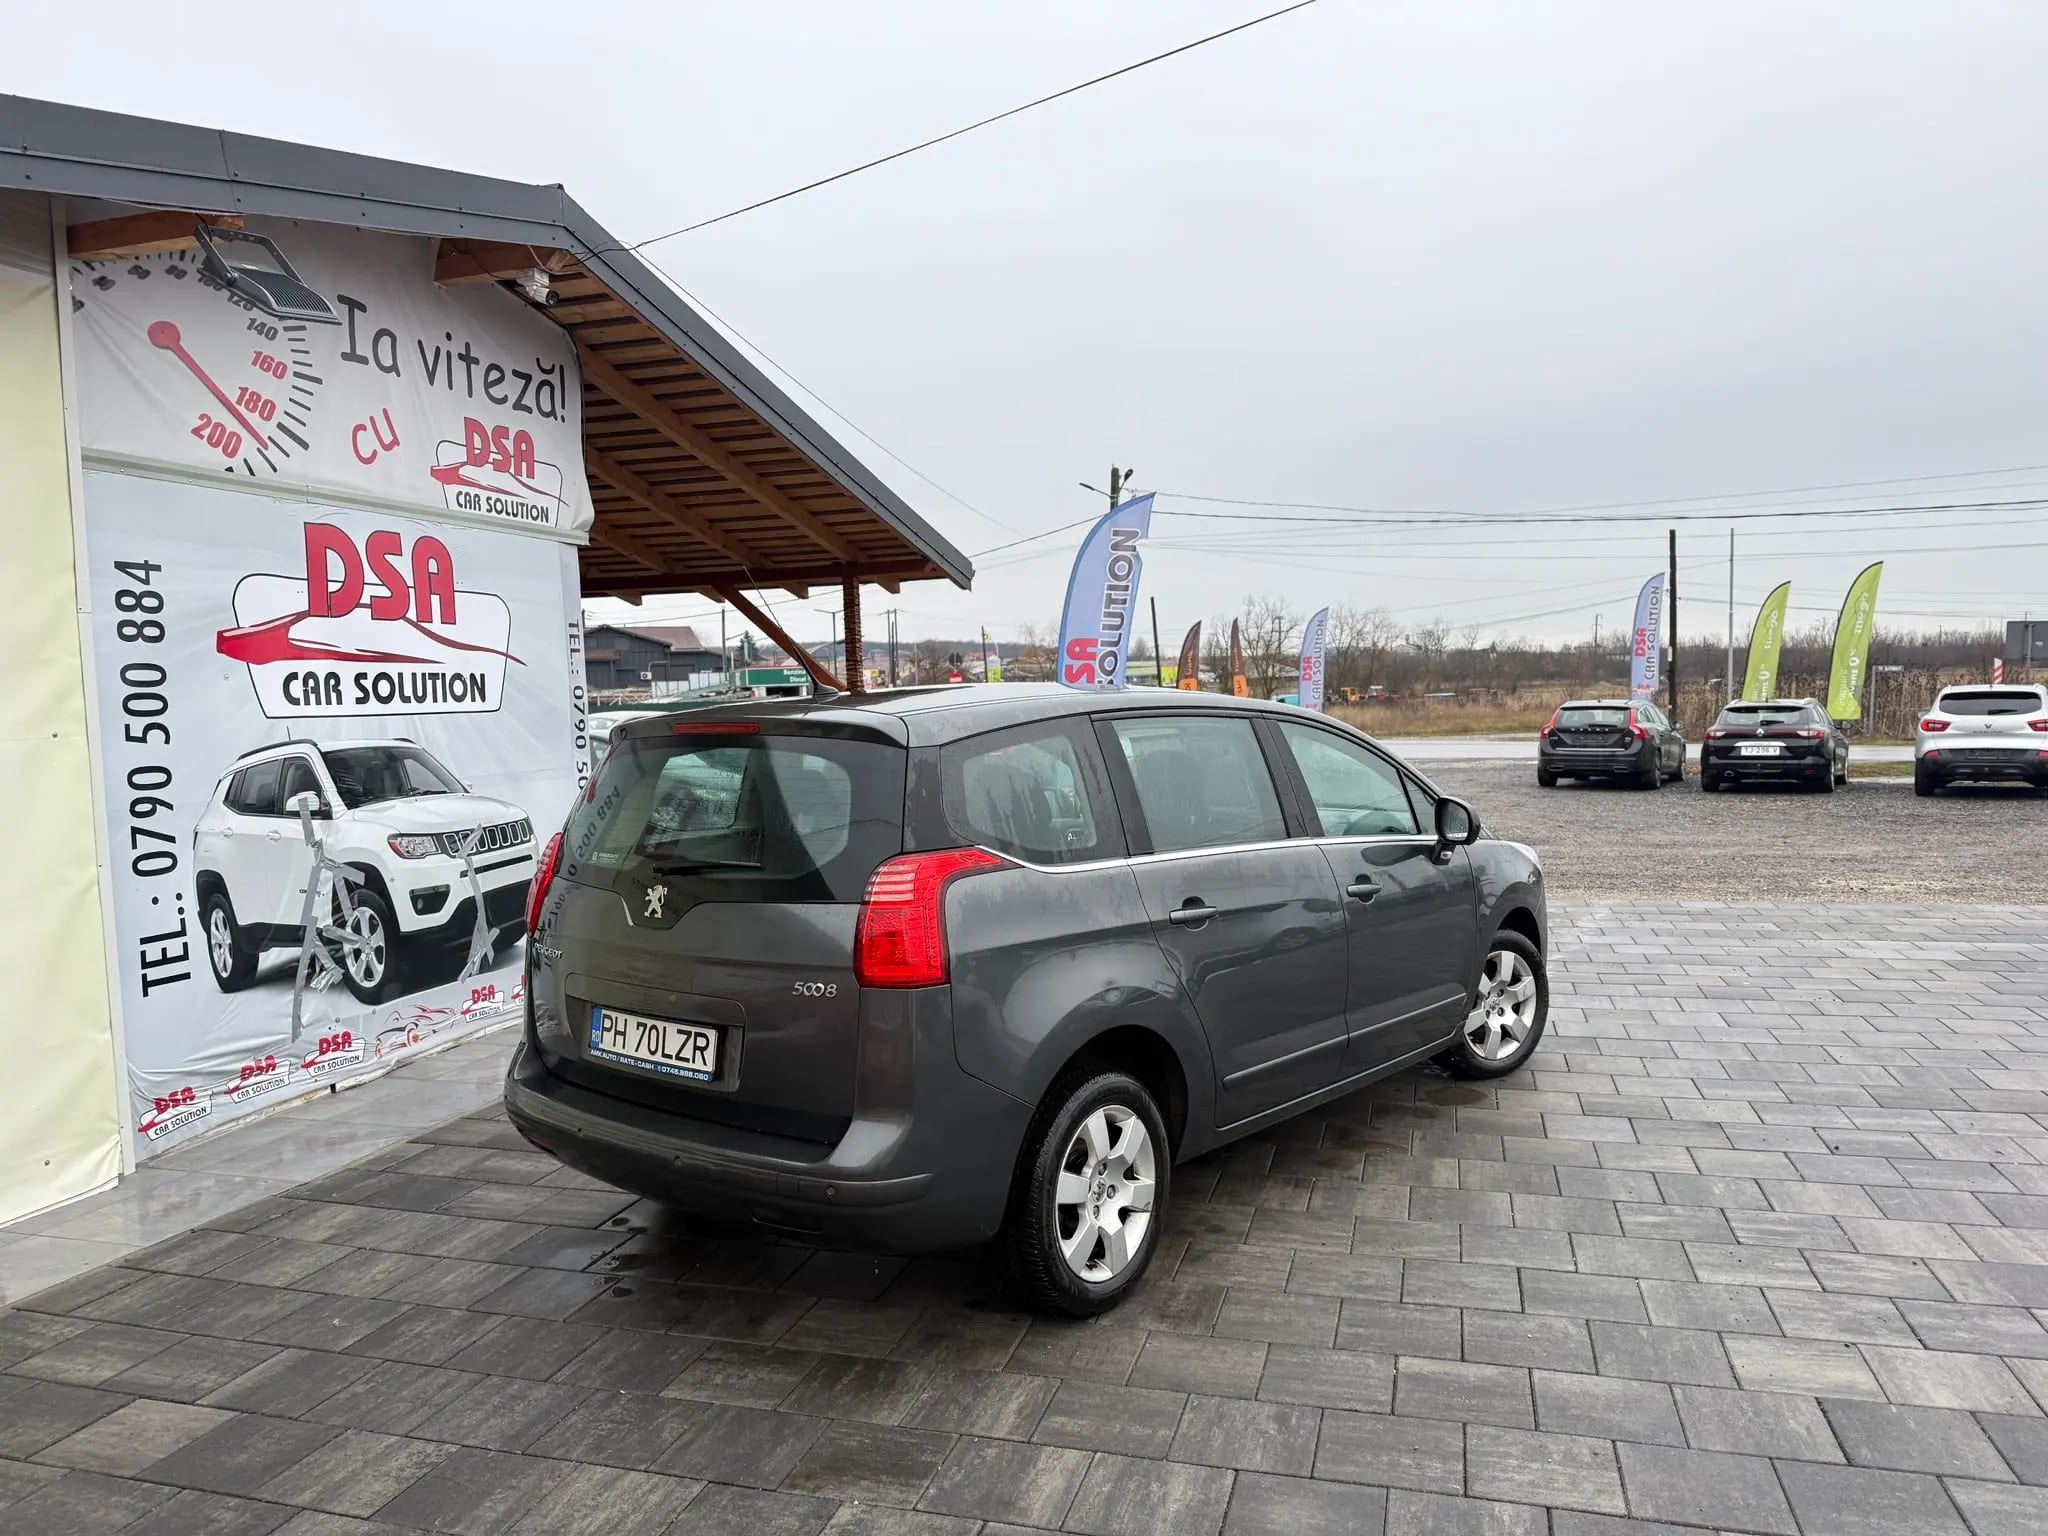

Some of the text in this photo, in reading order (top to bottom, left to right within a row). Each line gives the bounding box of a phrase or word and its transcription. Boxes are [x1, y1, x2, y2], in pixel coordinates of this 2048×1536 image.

[246, 317, 279, 342] 140
[251, 350, 288, 380] 160
[336, 293, 566, 424] Ia viteză!
[235, 386, 277, 423] 180
[190, 412, 243, 459] 200
[351, 407, 400, 466] cu
[463, 416, 535, 480] DSA
[456, 490, 549, 524] CAR SOLUTION
[303, 521, 457, 625] DSA
[568, 618, 581, 675] TEL.:
[1634, 627, 1647, 657] DSA
[1644, 585, 1660, 680] CAR SOLUTION
[1302, 655, 1312, 682] DSA
[1312, 619, 1324, 700] CAR SOLUTION
[282, 670, 486, 706] CAR SOLUTION
[573, 685, 587, 750] 0790
[113, 558, 192, 998] TEL.: 0790 500 884
[471, 984, 496, 1005] DSA
[792, 981, 837, 998] 5008
[318, 1031, 352, 1056] DSA
[600, 1013, 628, 1050] PH
[240, 1054, 277, 1081] DSA
[313, 1054, 360, 1074] CAR SOLUTION
[153, 1086, 196, 1114] DSA
[237, 1077, 286, 1100] CAR SOLUTION
[154, 1106, 207, 1136] CAR SOLUTION
